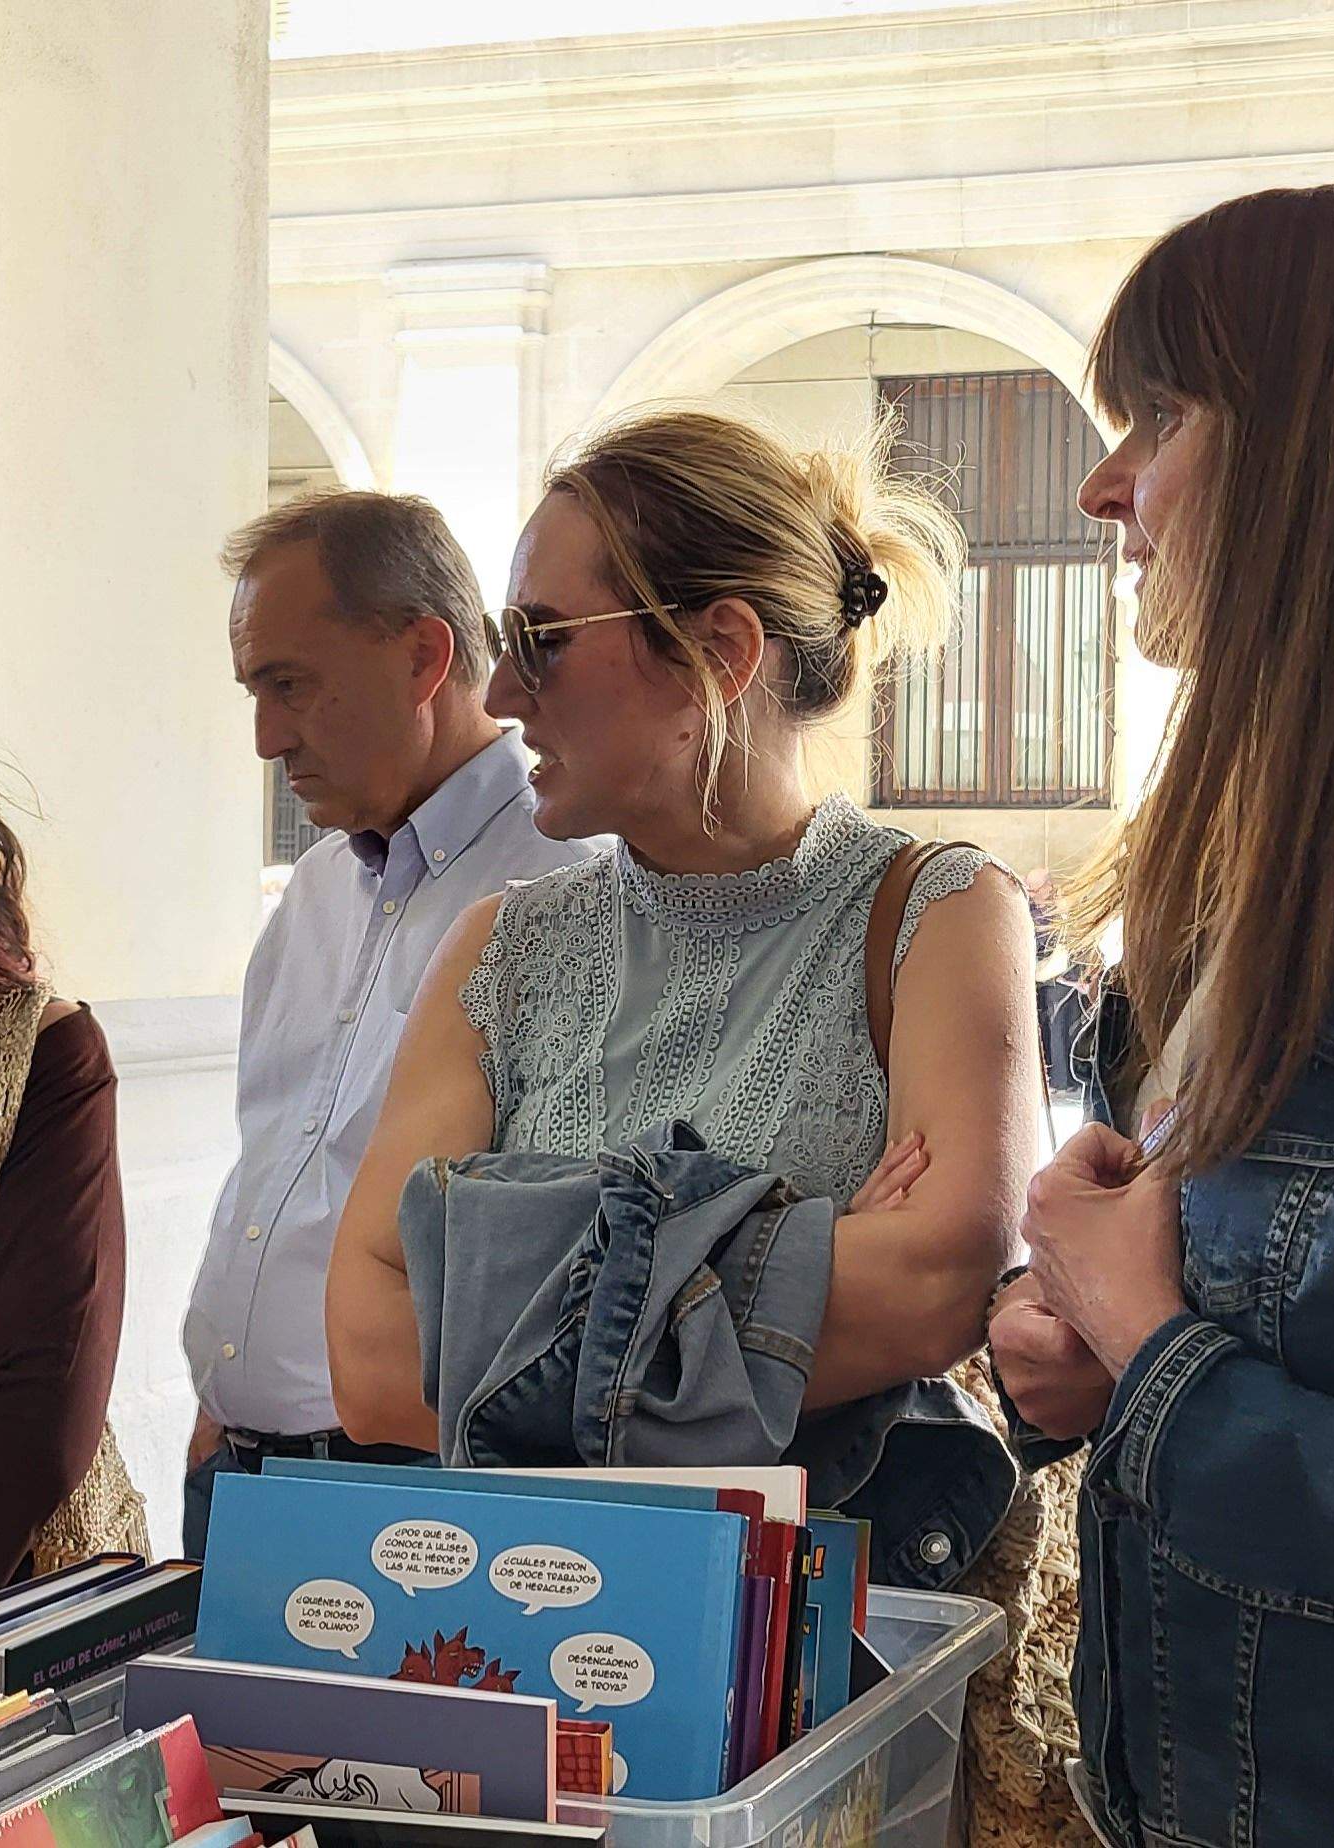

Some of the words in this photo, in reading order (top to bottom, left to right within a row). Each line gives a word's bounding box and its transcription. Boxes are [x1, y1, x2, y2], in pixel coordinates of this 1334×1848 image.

[395, 1528, 420, 1537] ¿POR
[445, 1532, 457, 1540] SE
[385, 1538, 423, 1549] CONOCE
[436, 1543, 468, 1553] ULISES
[380, 1550, 408, 1560] COMO
[411, 1552, 422, 1561] EL
[458, 1556, 470, 1565] DE
[504, 1556, 546, 1568] ¿CUÁLES
[549, 1560, 586, 1571] FUERON
[386, 1562, 403, 1570] LAS
[406, 1564, 421, 1573] MIL
[424, 1565, 463, 1576] TRETAS?
[495, 1568, 514, 1577] LOS
[518, 1570, 543, 1579] DOCE
[547, 1572, 597, 1584] TRABAJOS
[510, 1580, 522, 1589] DE
[525, 1582, 579, 1594] HERACLES?
[344, 1600, 364, 1609] SON
[302, 1608, 321, 1617] LOS
[324, 1611, 358, 1620] DIOSES
[299, 1619, 316, 1628] DEL
[319, 1621, 359, 1632] OLIMPO?
[33, 1670, 45, 1685] EL
[48, 1657, 75, 1679] CLUB
[78, 1650, 91, 1666] DE
[94, 1635, 126, 1661] CÓMIC
[128, 1629, 142, 1645] HA
[568, 1654, 639, 1669] DESENCADENÓ
[576, 1668, 587, 1676] LA
[591, 1669, 628, 1680] GUERRA
[575, 1679, 587, 1688] DE
[591, 1681, 627, 1692] TROYA?
